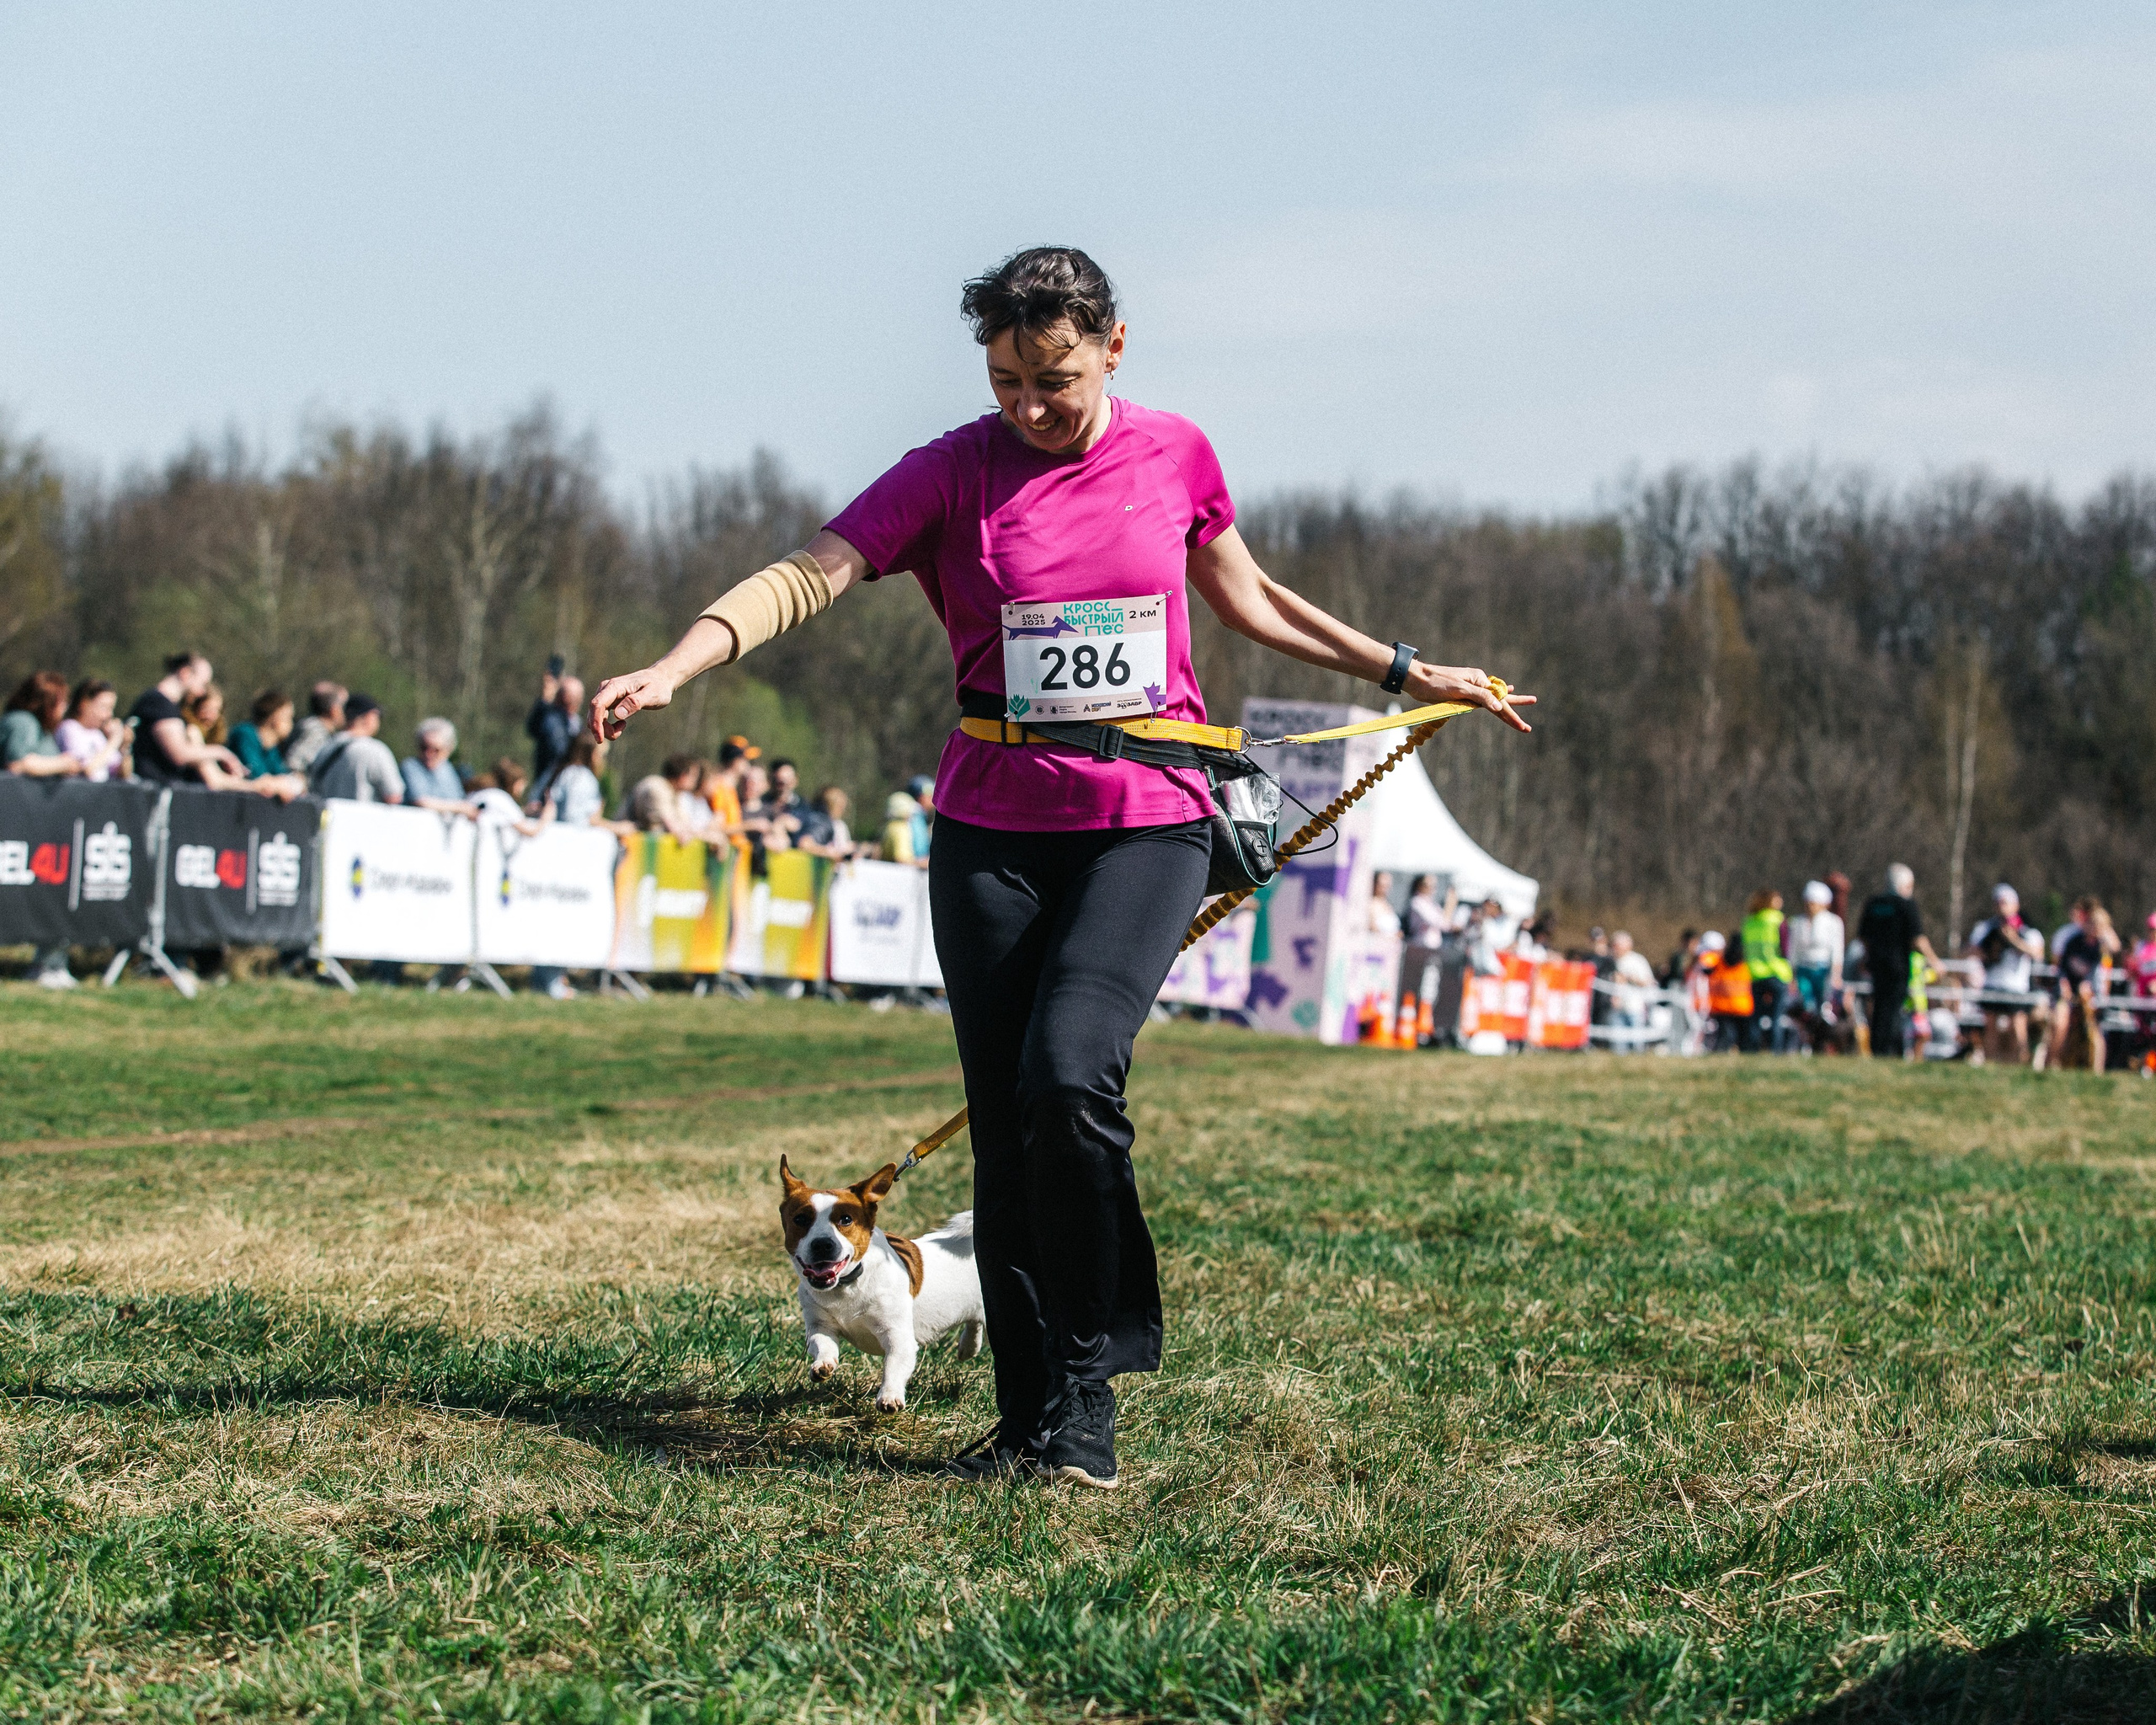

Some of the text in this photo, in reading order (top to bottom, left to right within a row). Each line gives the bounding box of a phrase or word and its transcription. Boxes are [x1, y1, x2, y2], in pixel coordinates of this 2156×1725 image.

[1064, 601, 1110, 614] КРОСС
[1129, 610, 1136, 619] 2
[1039, 642, 1131, 691] 286
